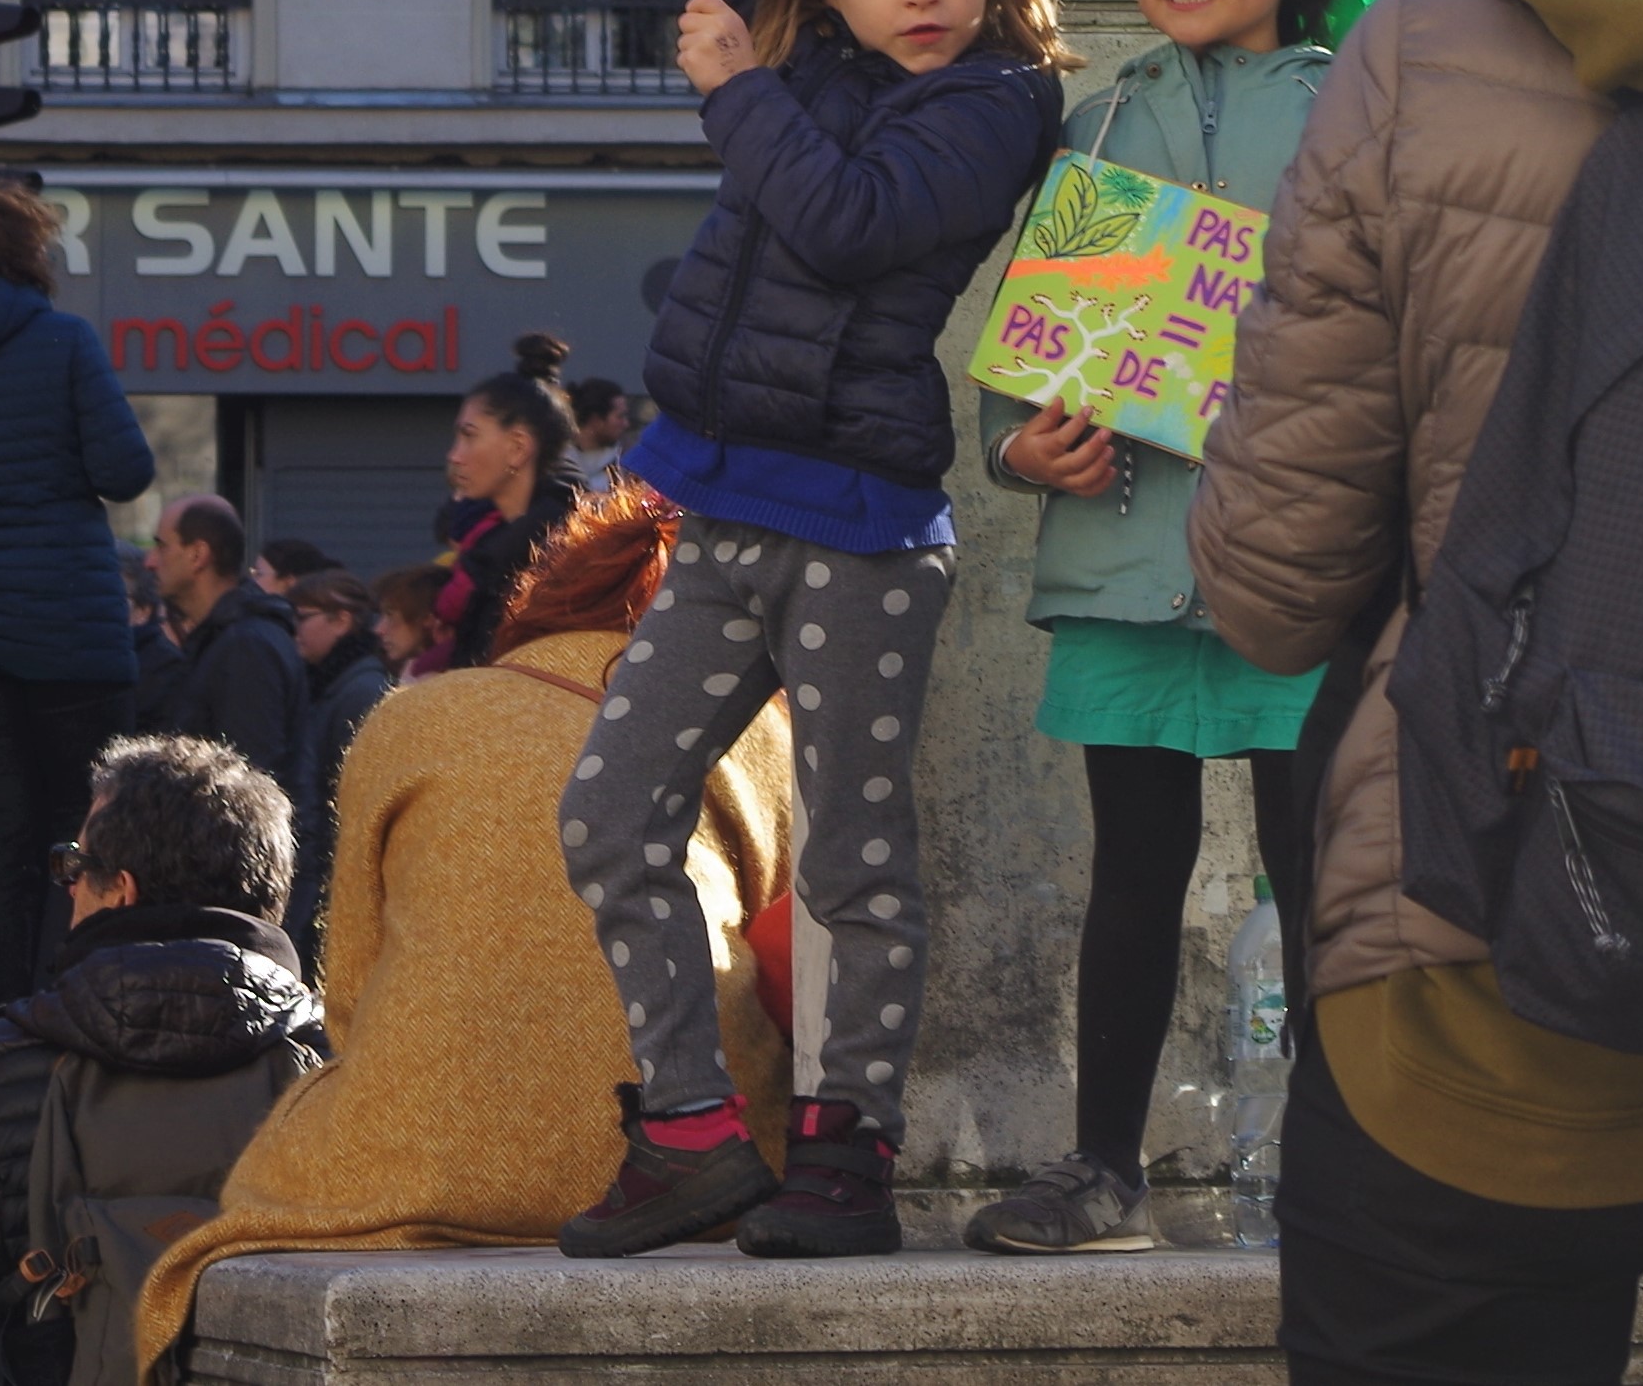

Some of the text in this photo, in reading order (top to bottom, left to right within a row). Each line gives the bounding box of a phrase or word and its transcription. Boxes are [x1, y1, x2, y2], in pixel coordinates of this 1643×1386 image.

[132, 188, 547, 279] SANTE
[1187, 208, 1255, 263] PAS
[1187, 264, 1256, 315] NA
[110, 299, 459, 372] médical
[999, 305, 1071, 361] PAS
[1113, 349, 1166, 398] DE
